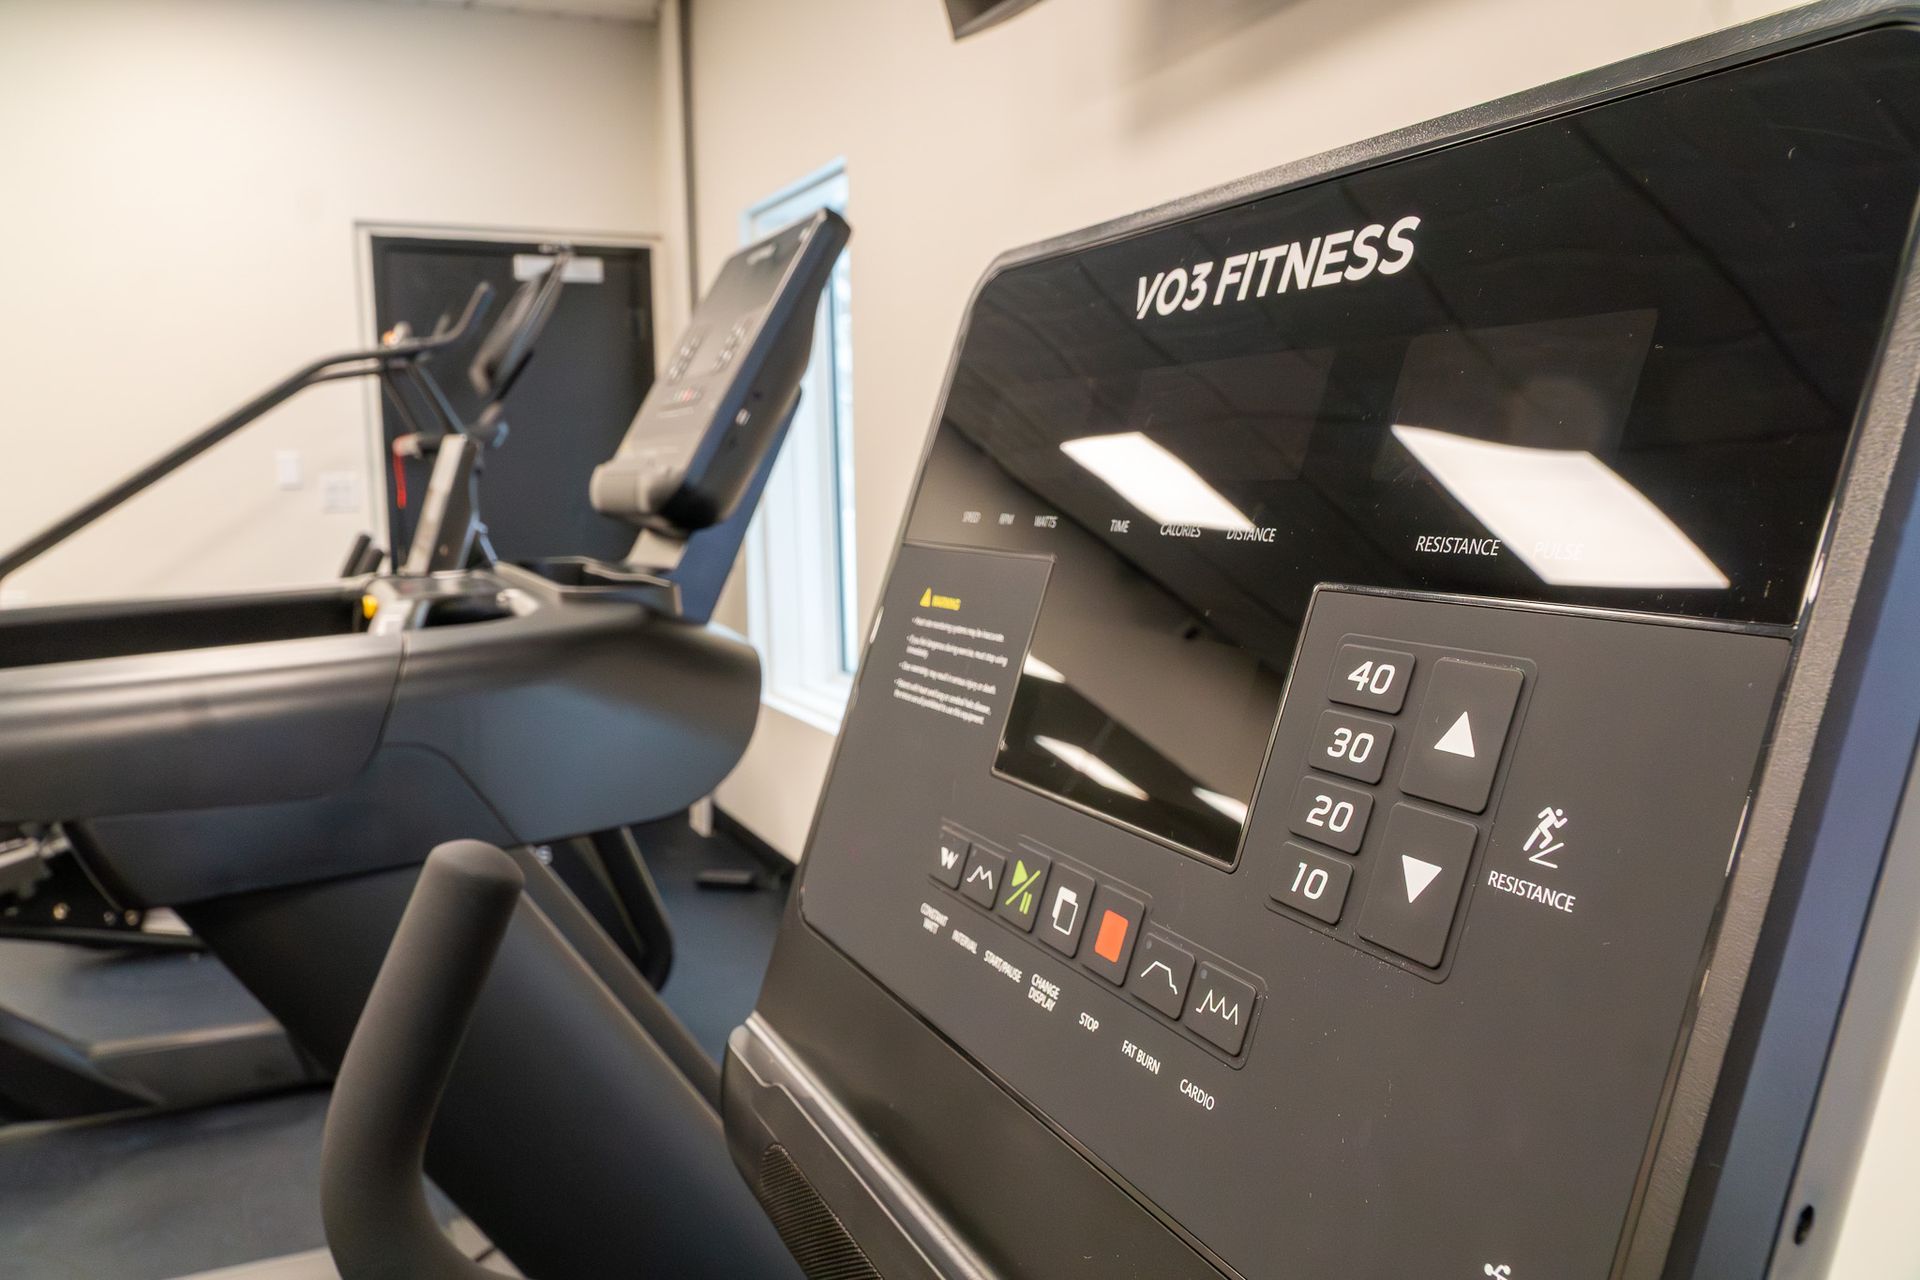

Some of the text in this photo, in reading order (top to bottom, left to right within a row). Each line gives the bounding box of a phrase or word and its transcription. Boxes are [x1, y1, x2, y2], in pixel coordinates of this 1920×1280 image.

[1136, 215, 1421, 320] VO3 FITNESS
[1110, 519, 1131, 533] TIME
[1160, 523, 1201, 538] CALORIES
[1226, 527, 1277, 542] DISTANCE
[1415, 535, 1500, 556] RESISTANCE
[1532, 541, 1584, 561] PULSE
[1347, 660, 1396, 695] 40
[1326, 727, 1375, 764] 30
[1305, 794, 1354, 833] 20
[1290, 862, 1329, 900] 10
[1487, 870, 1576, 913] RESISTANCE
[1027, 985, 1057, 1012] DISPLAY
[1031, 973, 1061, 999] CHANGE
[1078, 1011, 1100, 1033] STOP
[1121, 1039, 1161, 1075] FAT BURN
[1179, 1078, 1215, 1111] CARDIO
